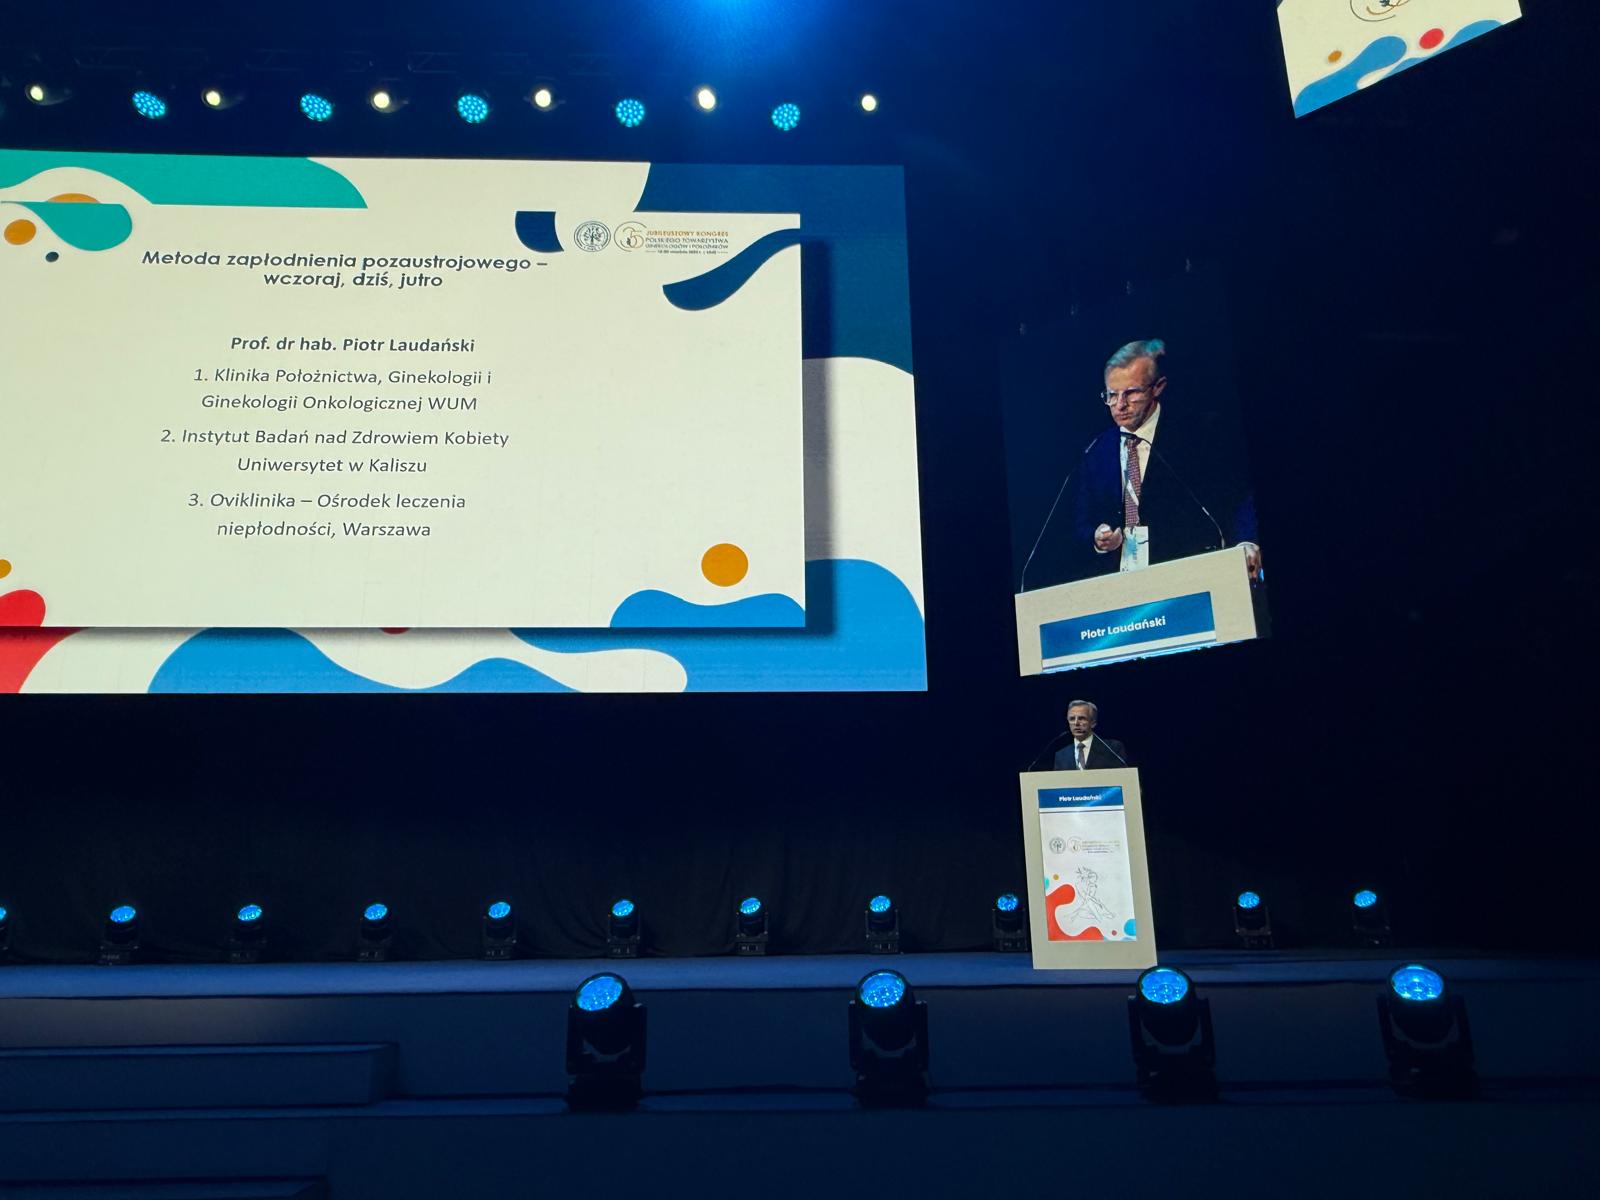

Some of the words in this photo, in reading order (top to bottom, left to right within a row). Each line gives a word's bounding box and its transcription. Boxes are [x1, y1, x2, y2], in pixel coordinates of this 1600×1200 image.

[142, 250, 220, 265] Metoda
[226, 253, 356, 269] zapłodnienia
[362, 253, 531, 271] pozaustrojowego
[263, 271, 346, 289] wczoraj,
[352, 271, 394, 288] dziś,
[398, 273, 443, 288] jutro
[231, 336, 270, 349] Prof.
[277, 337, 295, 350] dr
[300, 337, 336, 351] hab.
[343, 338, 384, 351] Piotr
[390, 338, 475, 353] Laudański
[194, 369, 208, 381] 1.
[215, 368, 269, 381] Klinika
[276, 369, 382, 385] Położnictwa,
[388, 370, 481, 387] Ginekologii
[486, 371, 492, 384] i
[202, 395, 297, 412] Ginekologii
[303, 396, 422, 413] Onkologicznej
[428, 398, 477, 411] WUM
[161, 430, 175, 442] 2.
[182, 430, 250, 446] Instytut
[256, 429, 308, 444] Badań
[315, 430, 346, 444] nad
[352, 430, 439, 445] Zdrowiem
[445, 431, 510, 449] Kobiety
[237, 457, 343, 474] Uniwersytet
[349, 462, 363, 472] w
[370, 458, 427, 473] Kaliszu
[188, 494, 204, 507] 3.
[211, 493, 295, 508] Oviklinika
[317, 492, 391, 508] Ośrodek
[396, 494, 466, 509] leczenia
[217, 520, 336, 539] niepłodności,
[343, 523, 431, 537] Warszawa
[1080, 629, 1106, 641] Piotr
[1107, 615, 1166, 635] Laudański
